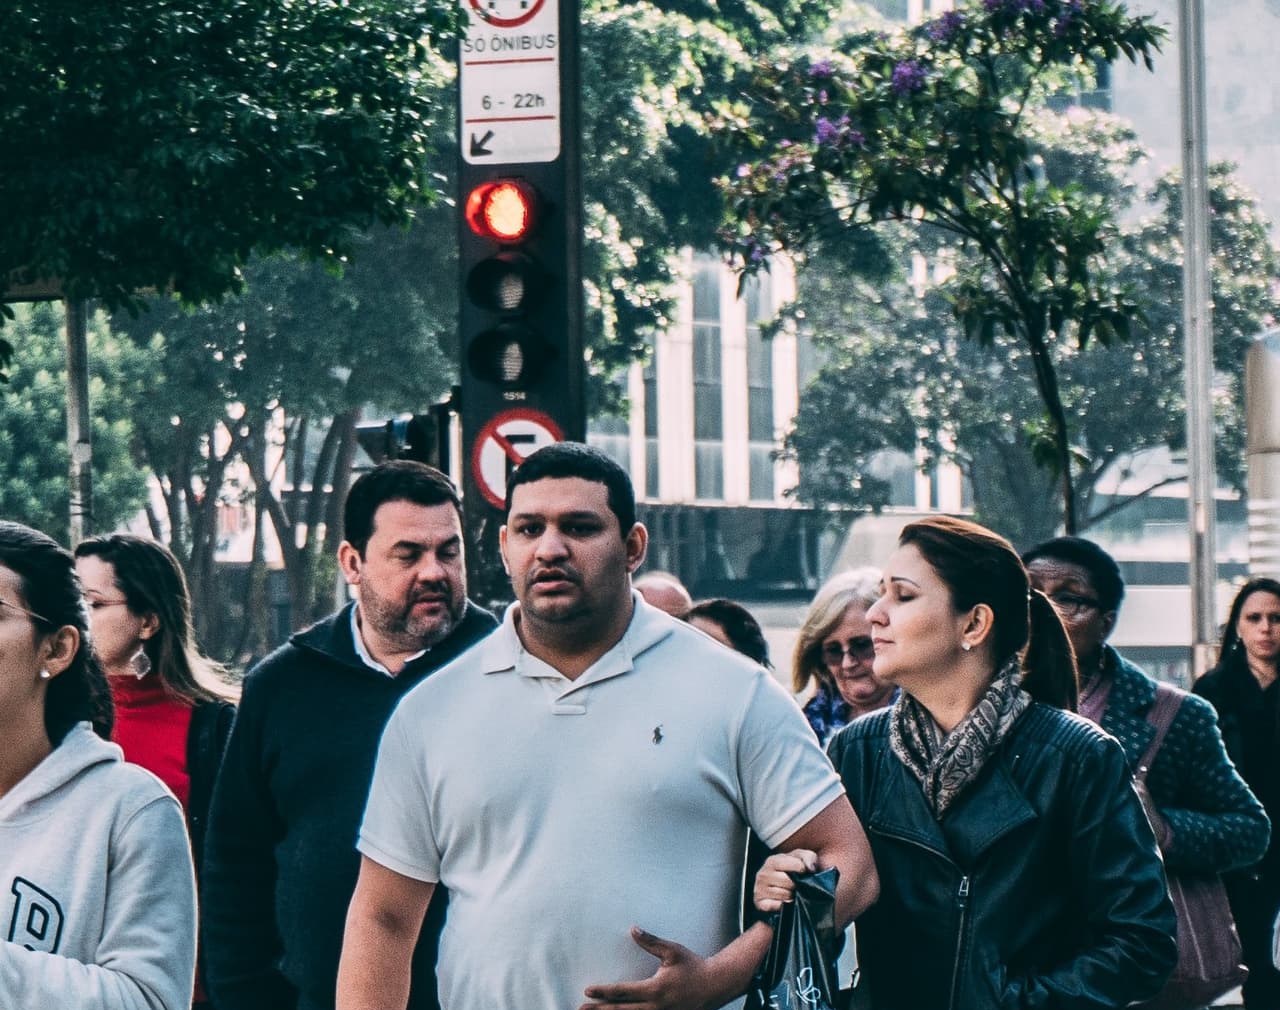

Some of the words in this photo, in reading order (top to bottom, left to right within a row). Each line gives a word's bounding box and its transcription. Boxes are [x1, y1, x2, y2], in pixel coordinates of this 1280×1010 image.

[464, 34, 486, 53] SÓ
[491, 33, 556, 52] ÔNIBUS
[482, 95, 492, 110] 6
[514, 93, 545, 108] 22h
